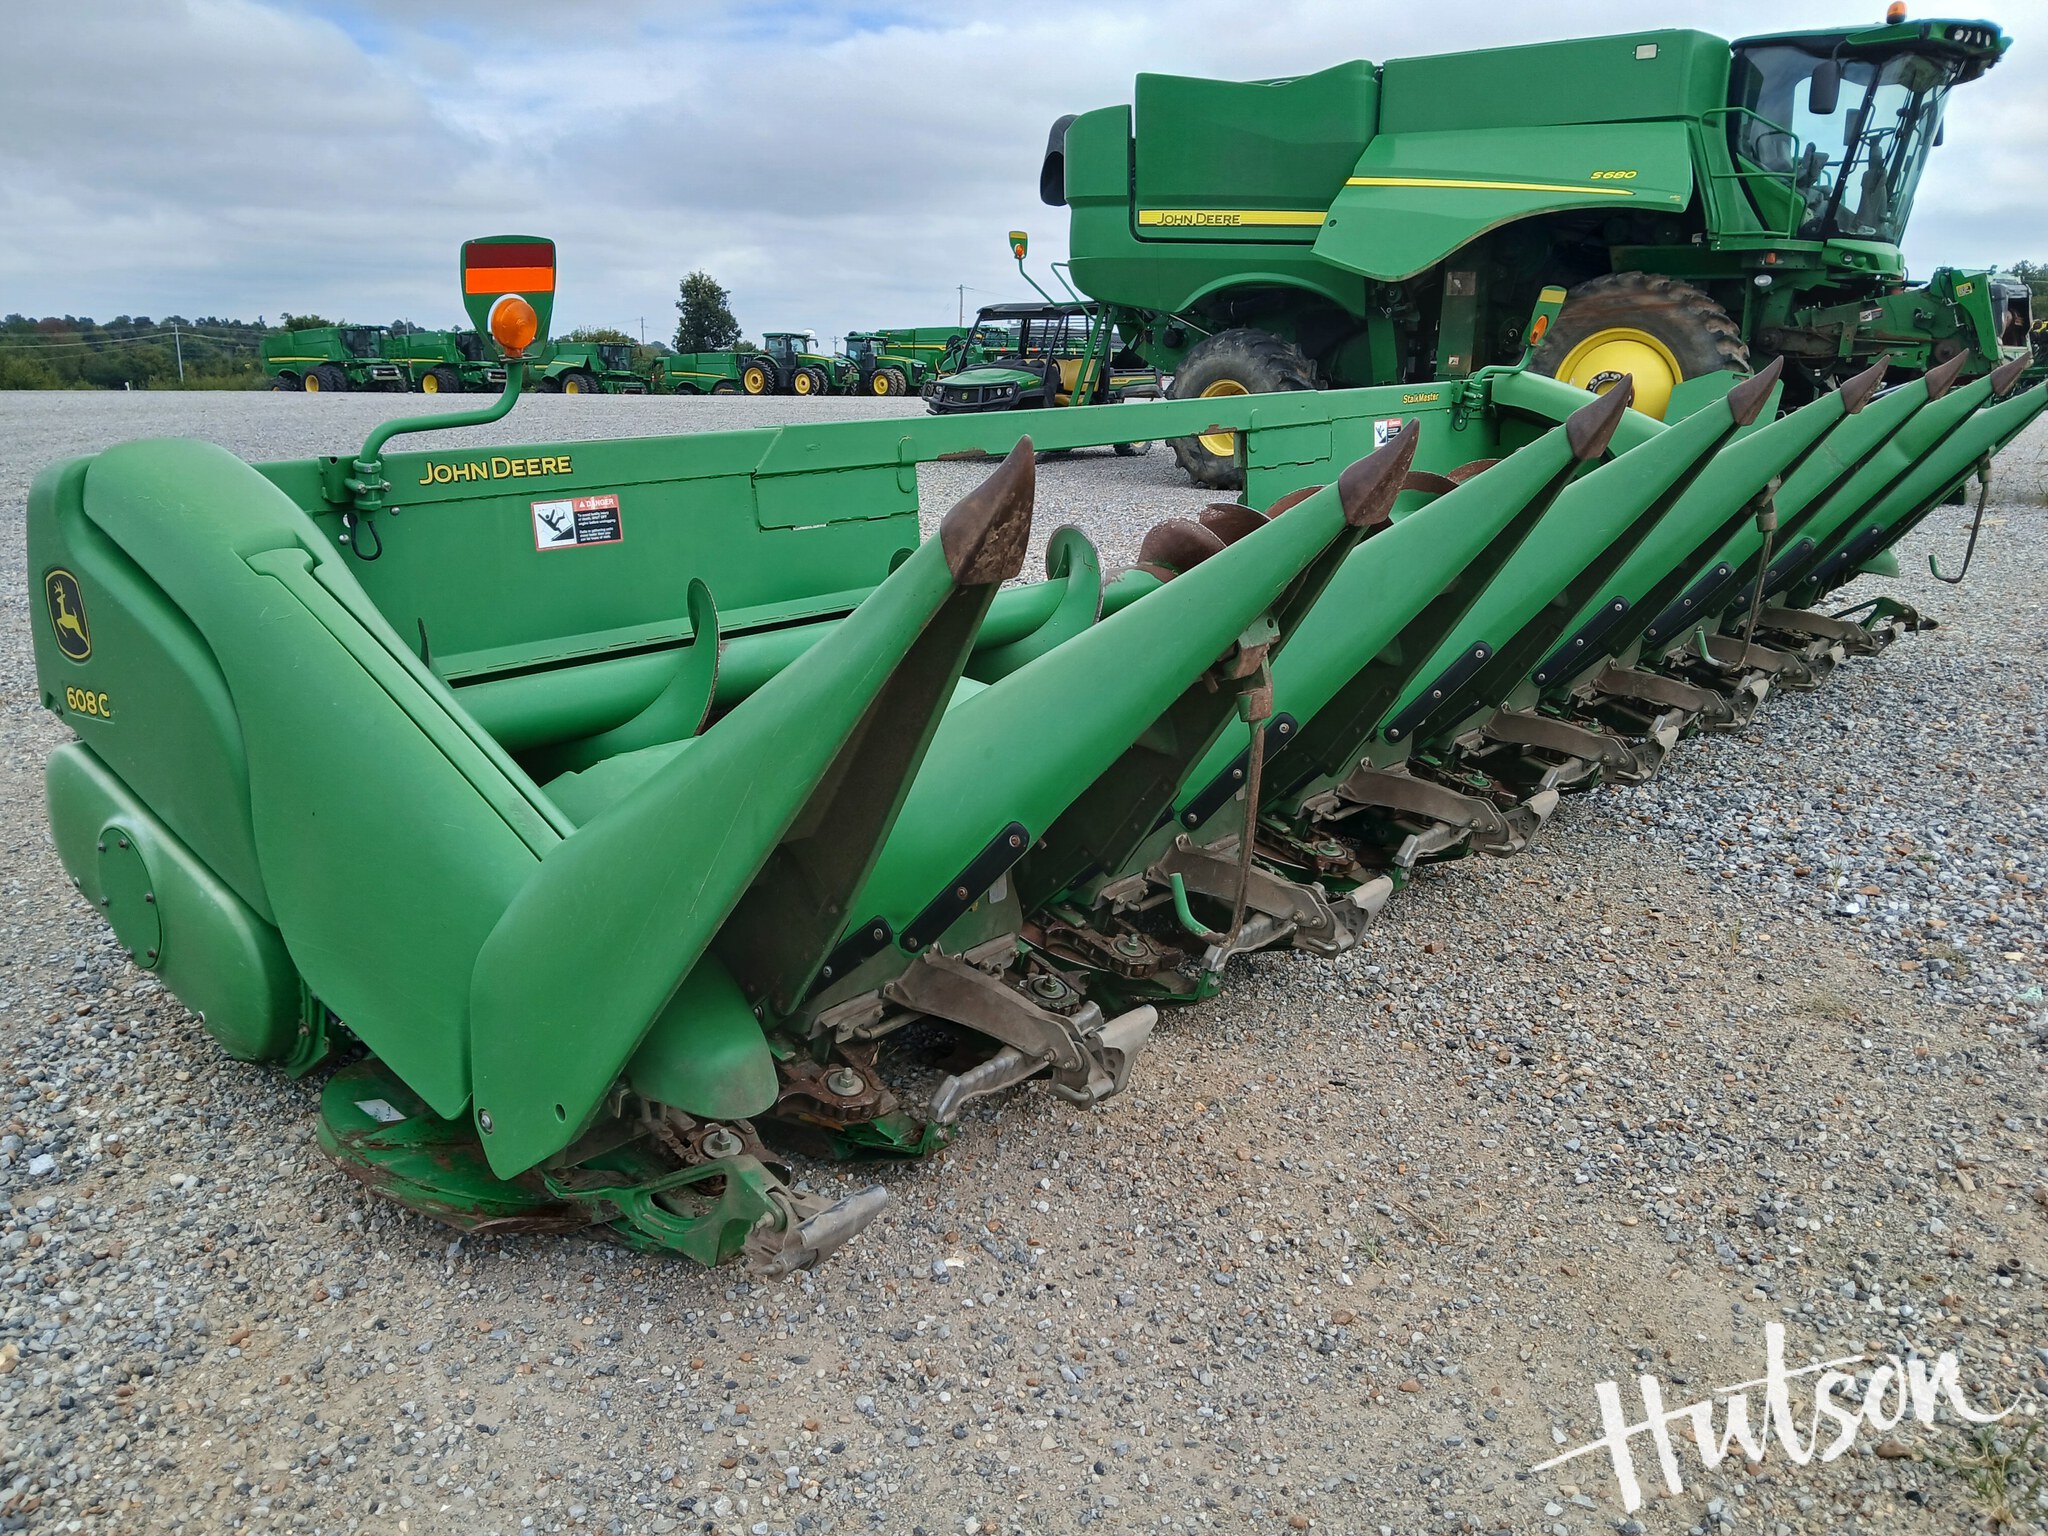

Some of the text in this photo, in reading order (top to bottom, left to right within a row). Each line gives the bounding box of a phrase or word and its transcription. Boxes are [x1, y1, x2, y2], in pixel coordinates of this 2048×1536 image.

[1590, 170, 1638, 180] S680
[1157, 212, 1241, 225] JOHN DEERE
[1402, 392, 1440, 404] StalkMaster
[419, 456, 573, 485] JOHN DEERE
[586, 498, 614, 509] DANGER
[66, 685, 111, 718] 608C
